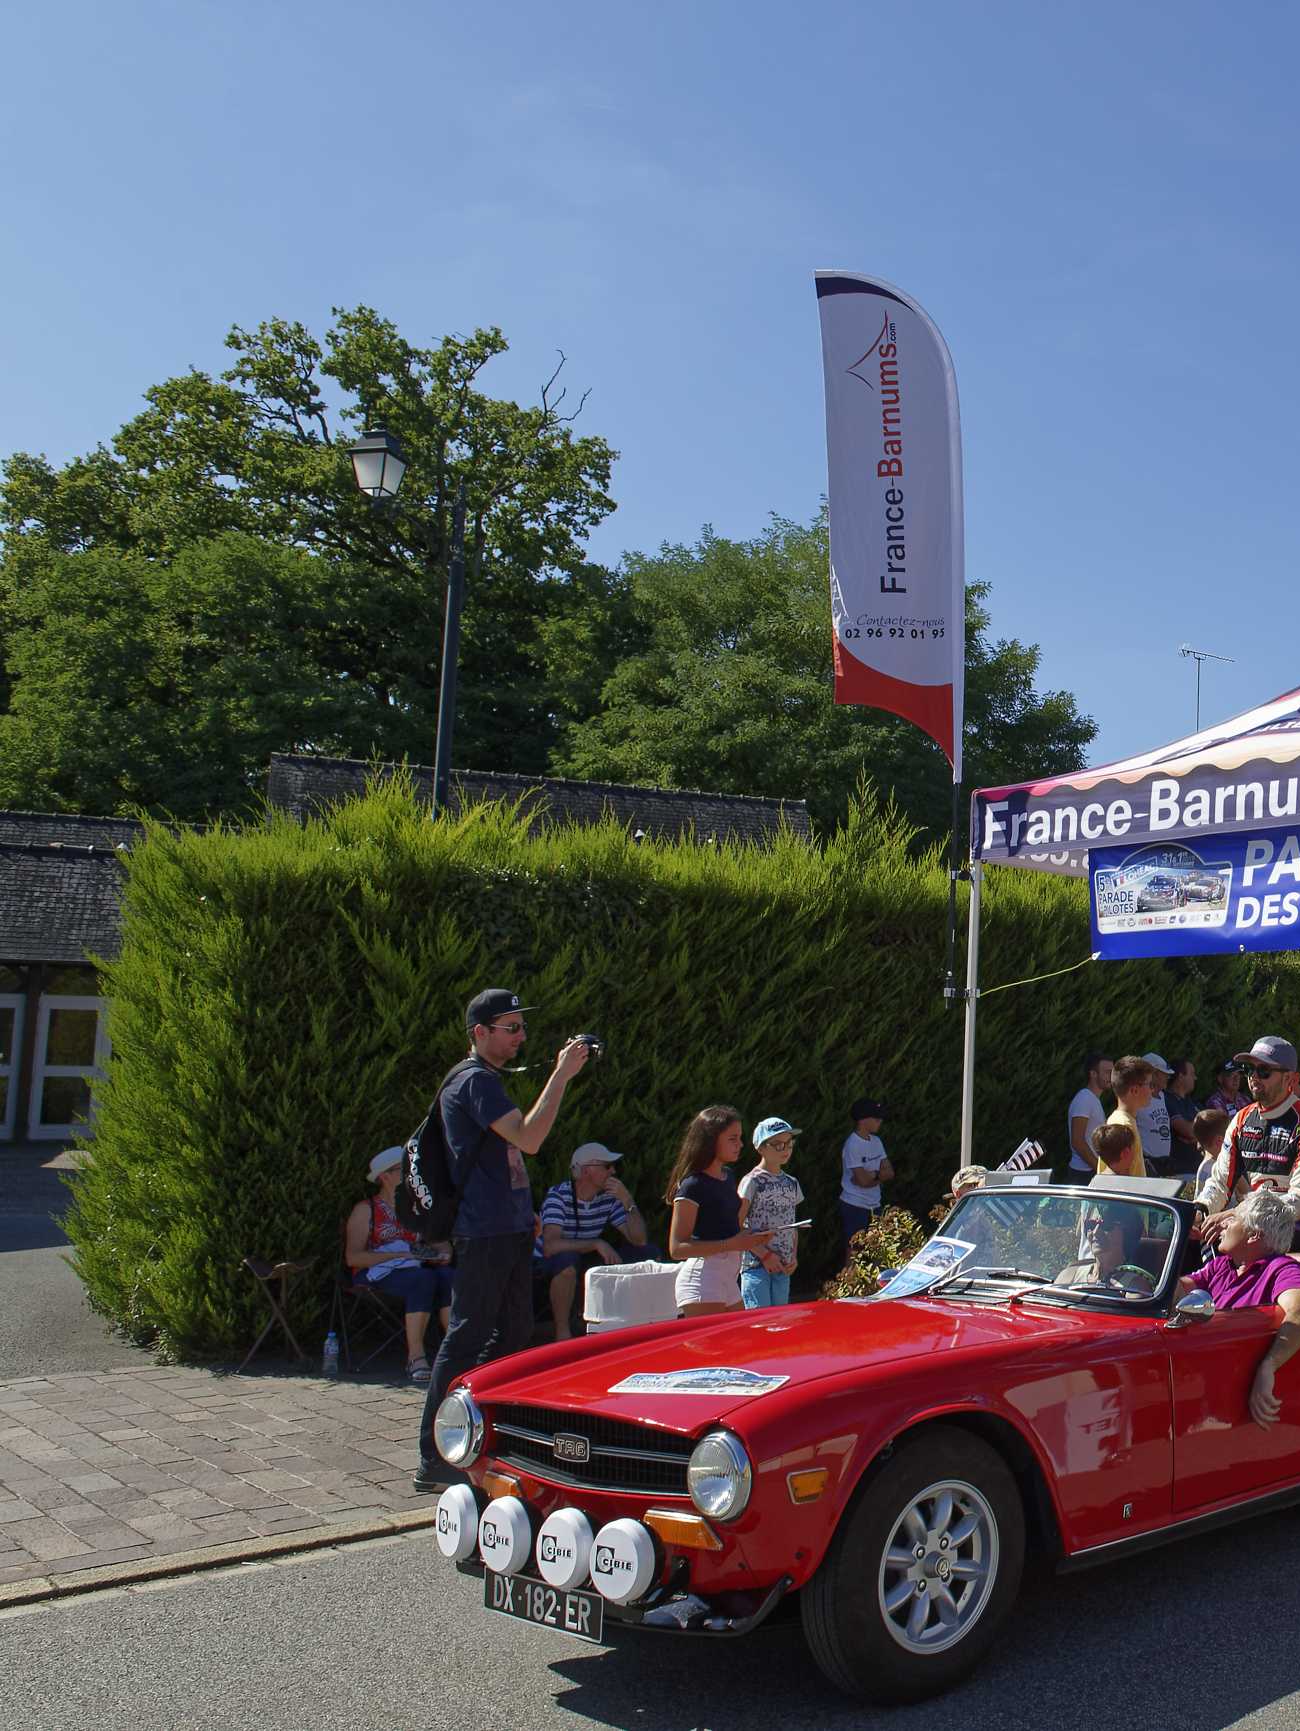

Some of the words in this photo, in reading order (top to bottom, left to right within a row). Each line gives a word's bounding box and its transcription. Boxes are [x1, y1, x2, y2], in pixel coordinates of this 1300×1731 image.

[845, 629, 860, 639] 02
[867, 628, 882, 638] 96
[889, 628, 904, 638] 92
[911, 629, 924, 639] 01
[932, 628, 945, 638] 95
[1235, 892, 1300, 929] DES
